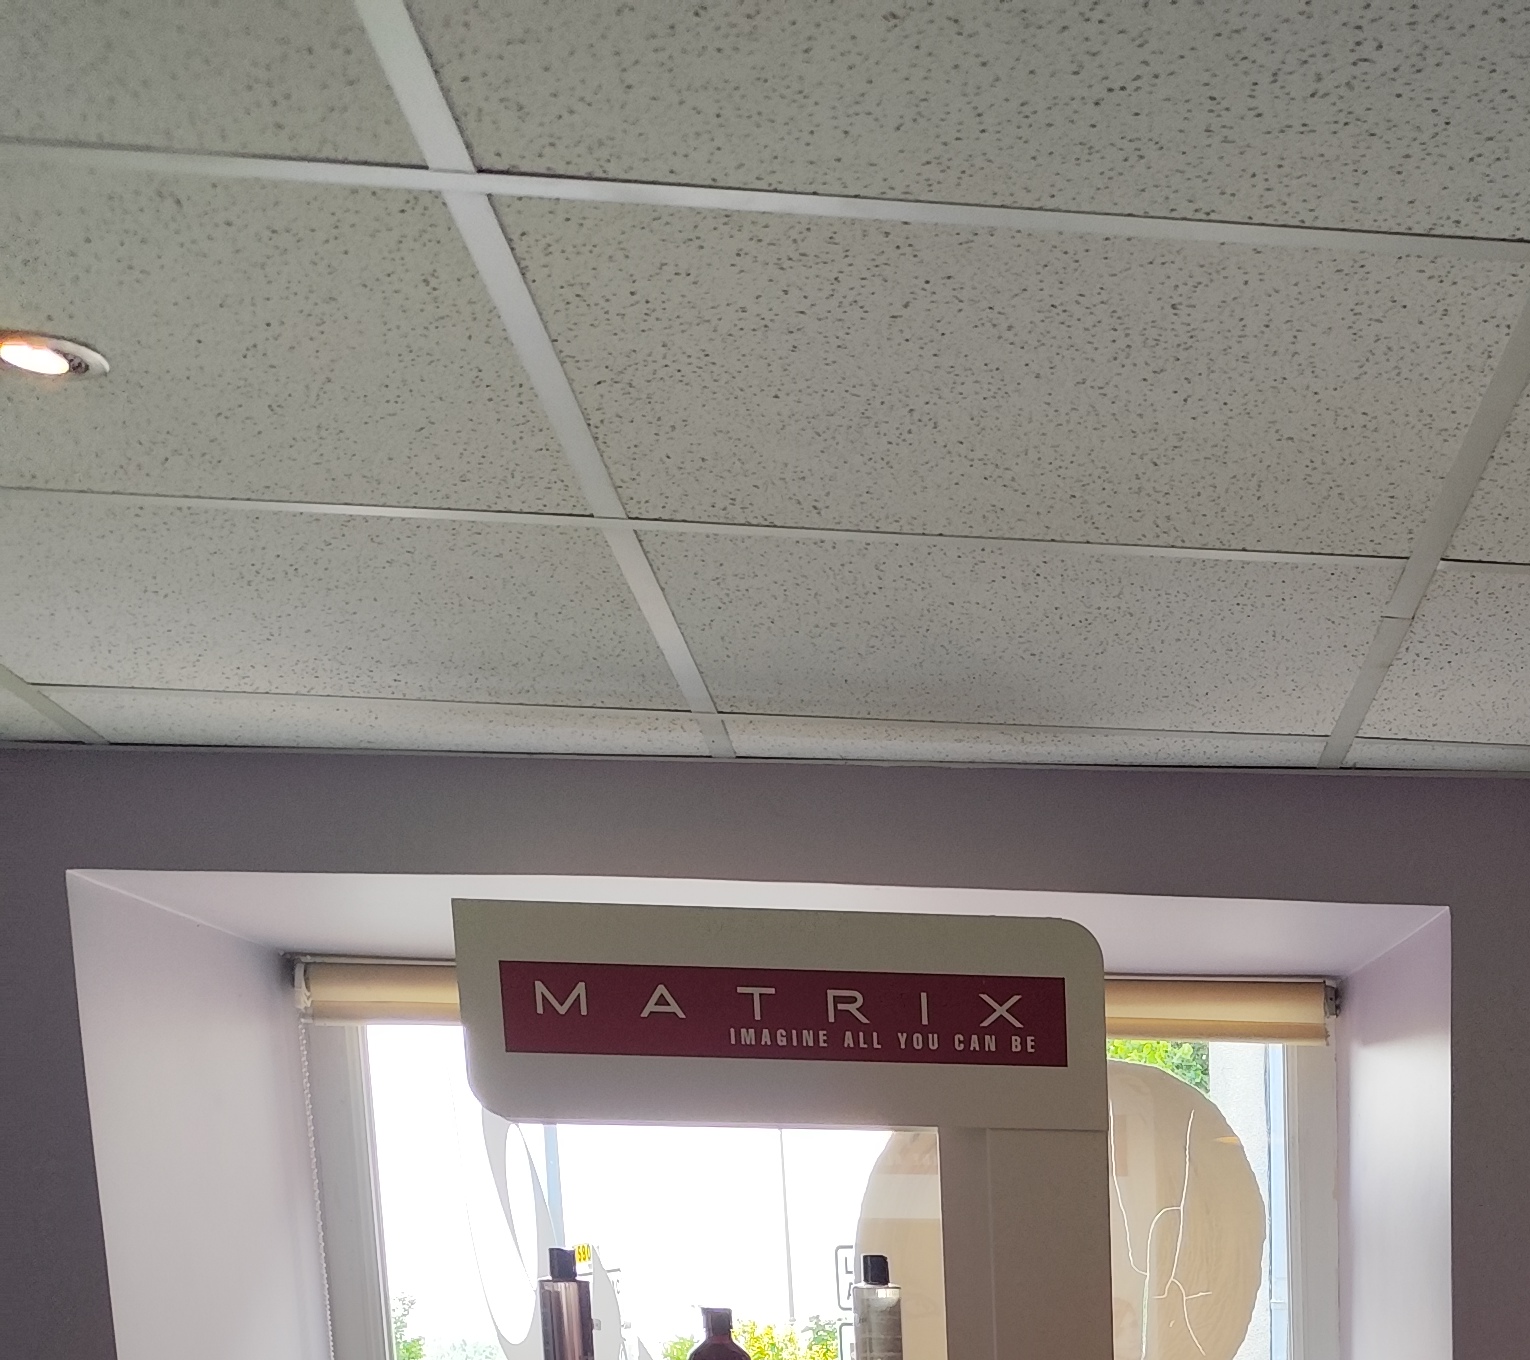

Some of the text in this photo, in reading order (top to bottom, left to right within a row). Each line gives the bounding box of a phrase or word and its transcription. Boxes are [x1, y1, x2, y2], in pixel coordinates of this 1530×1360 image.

[534, 980, 1025, 1029] MATRIX
[729, 1026, 1037, 1053] IMAGINE ALL YOU CAN BE
